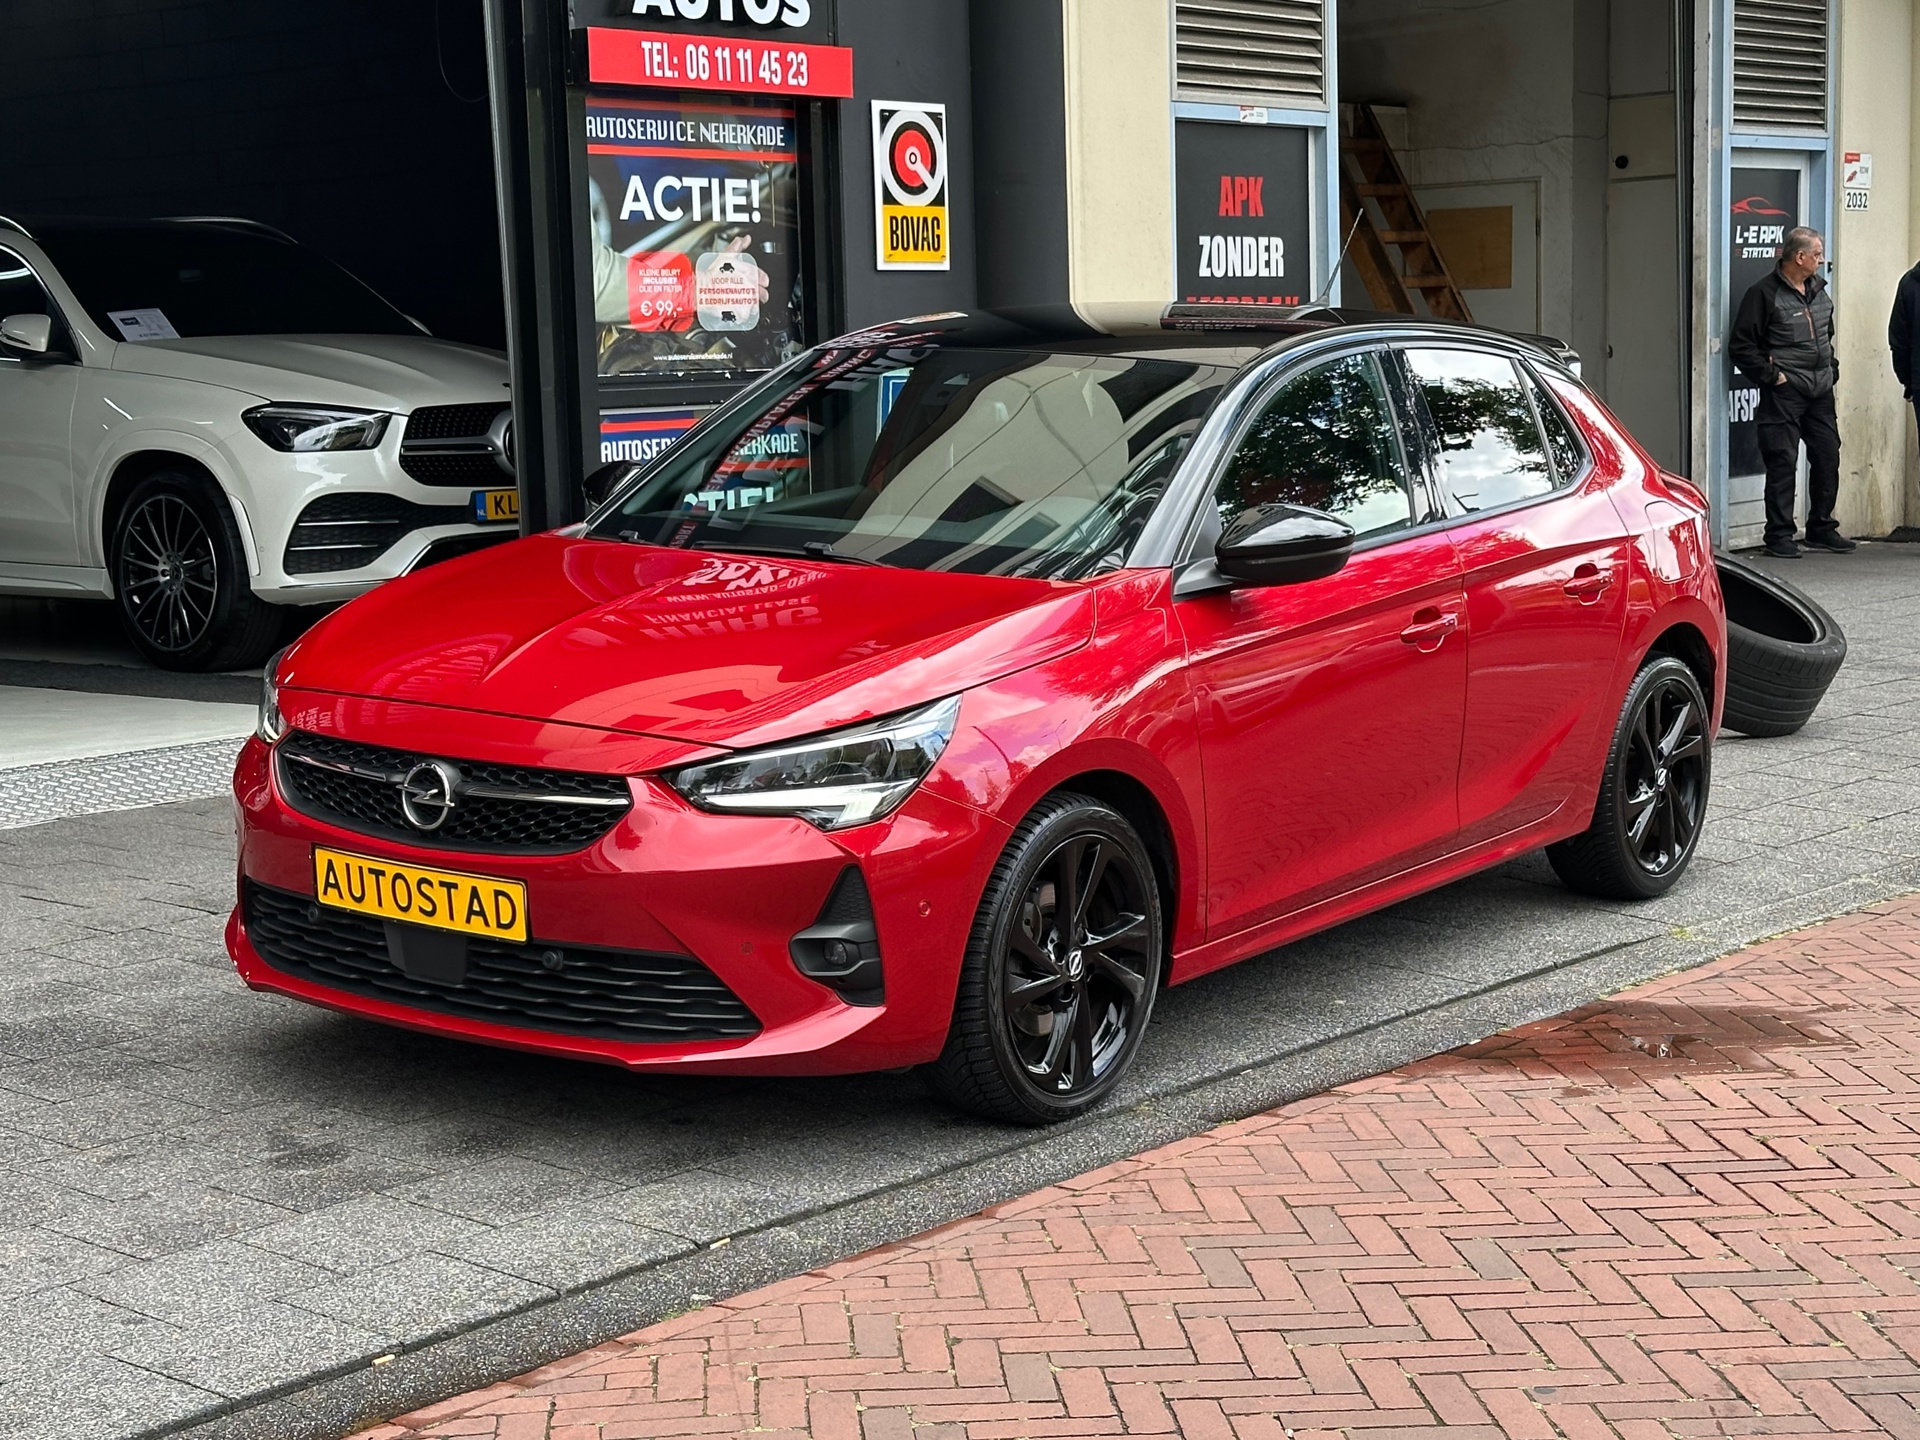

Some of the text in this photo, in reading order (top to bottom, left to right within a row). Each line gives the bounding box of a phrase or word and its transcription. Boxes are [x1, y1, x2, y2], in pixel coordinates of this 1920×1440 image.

[641, 41, 808, 87] TEL: 06 11 11 45 23
[586, 116, 785, 146] AUTOSERVICE NEHERKADE
[619, 175, 762, 224] ACTIE!
[1218, 176, 1264, 217] APK
[1846, 192, 1868, 208] 2032
[889, 215, 941, 252] BOVAG
[1735, 225, 1784, 244] L-E APK
[1198, 235, 1284, 278] ZONDER
[1742, 247, 1775, 259] STATION
[712, 277, 744, 285] VOOR ALLE
[322, 858, 517, 930] AUTOSTAD
